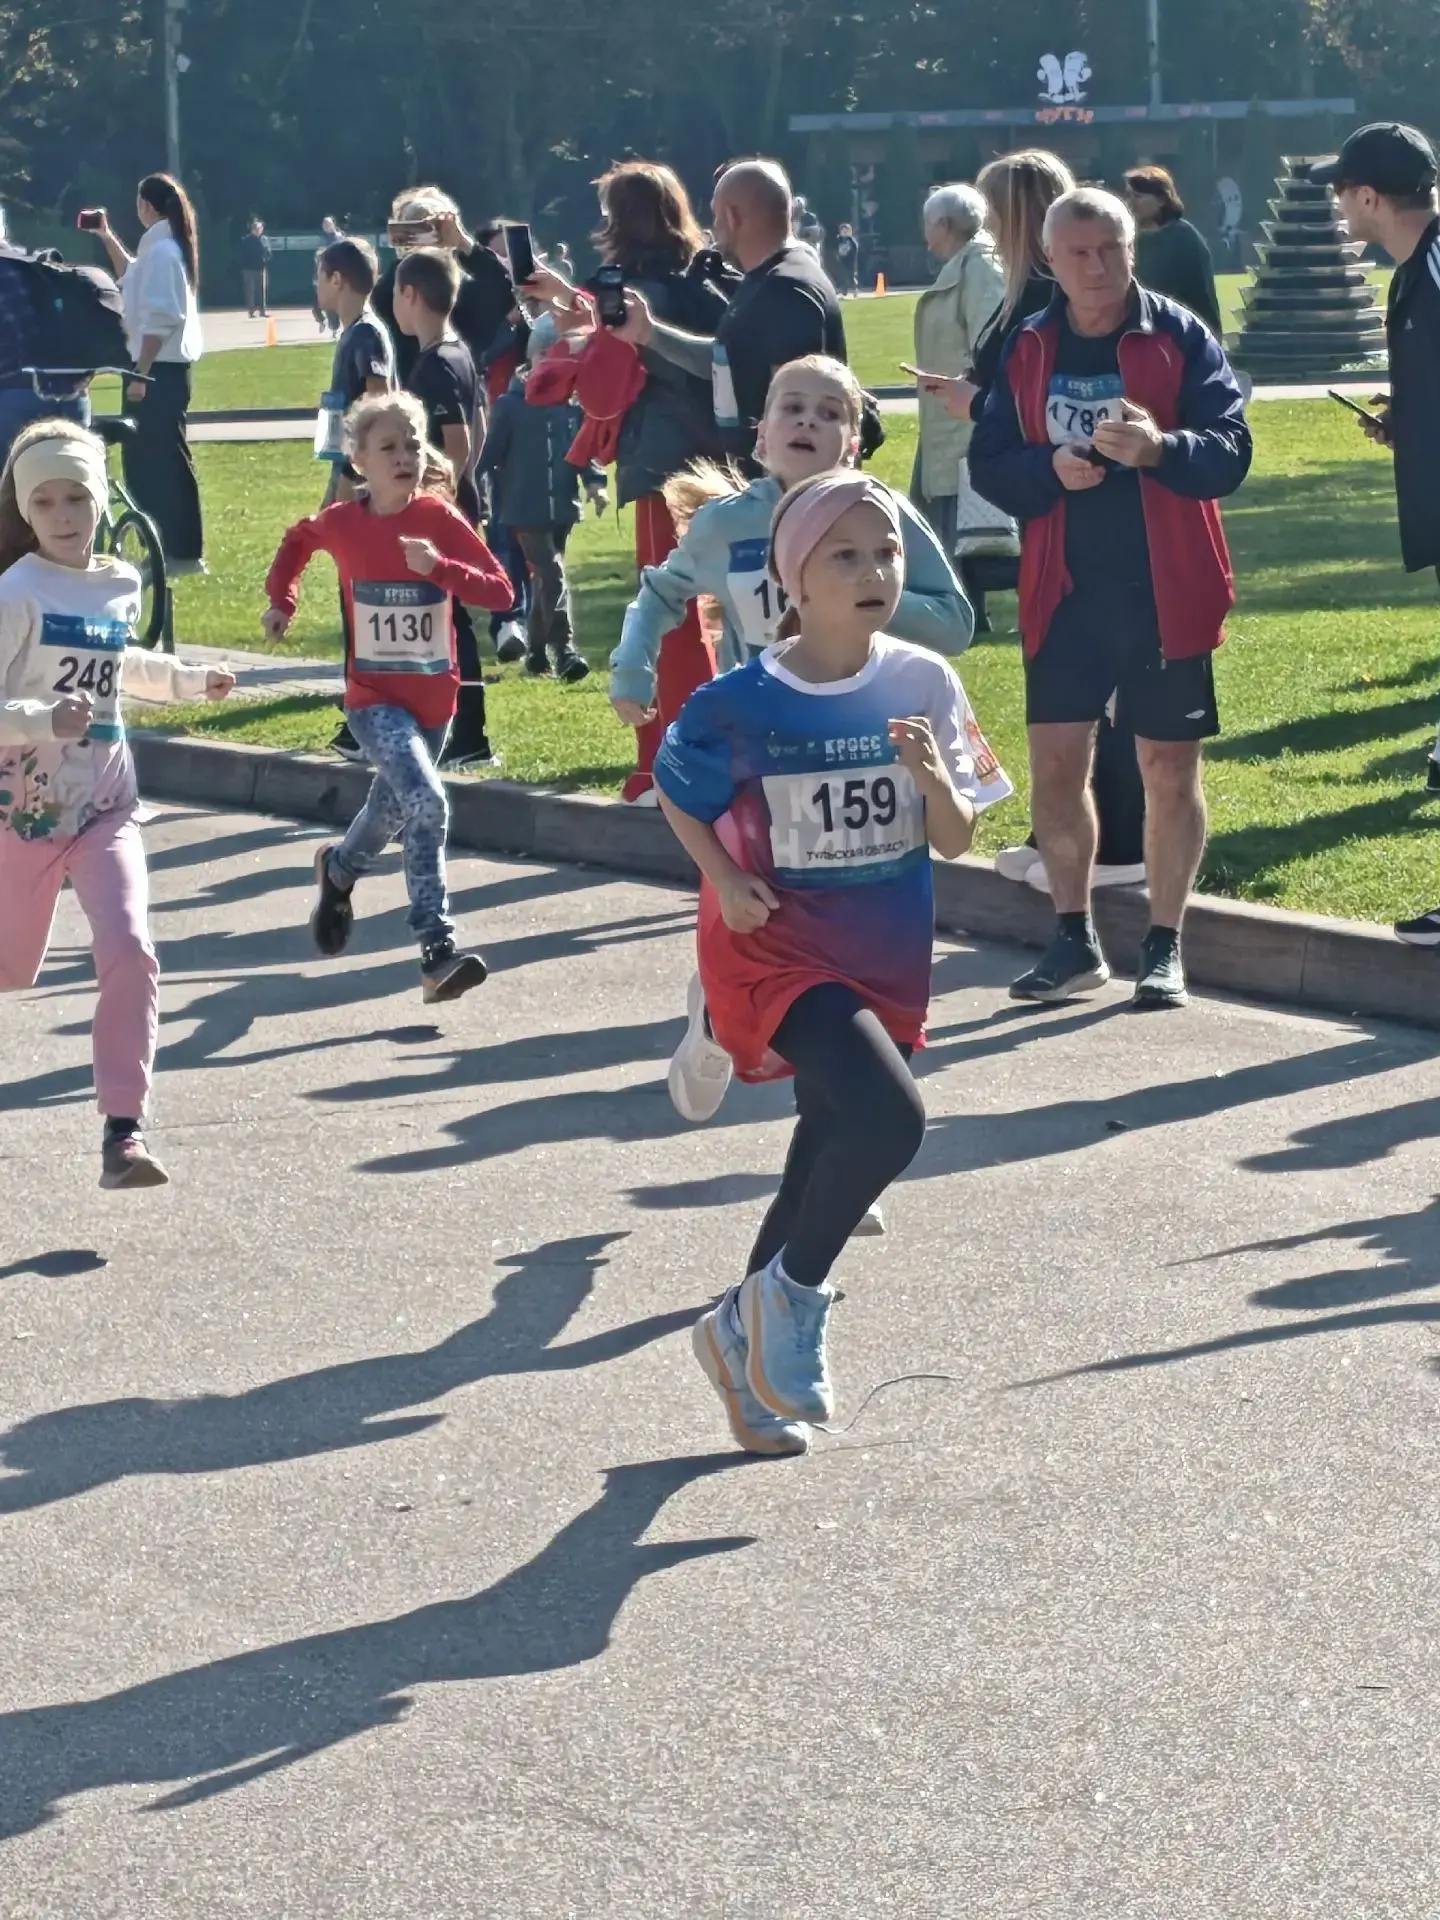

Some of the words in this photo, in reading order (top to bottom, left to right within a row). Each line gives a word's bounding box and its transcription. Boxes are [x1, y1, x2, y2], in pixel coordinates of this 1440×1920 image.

[368, 612, 433, 643] 1130
[824, 735, 882, 755] КРОСС
[812, 777, 896, 832] 159
